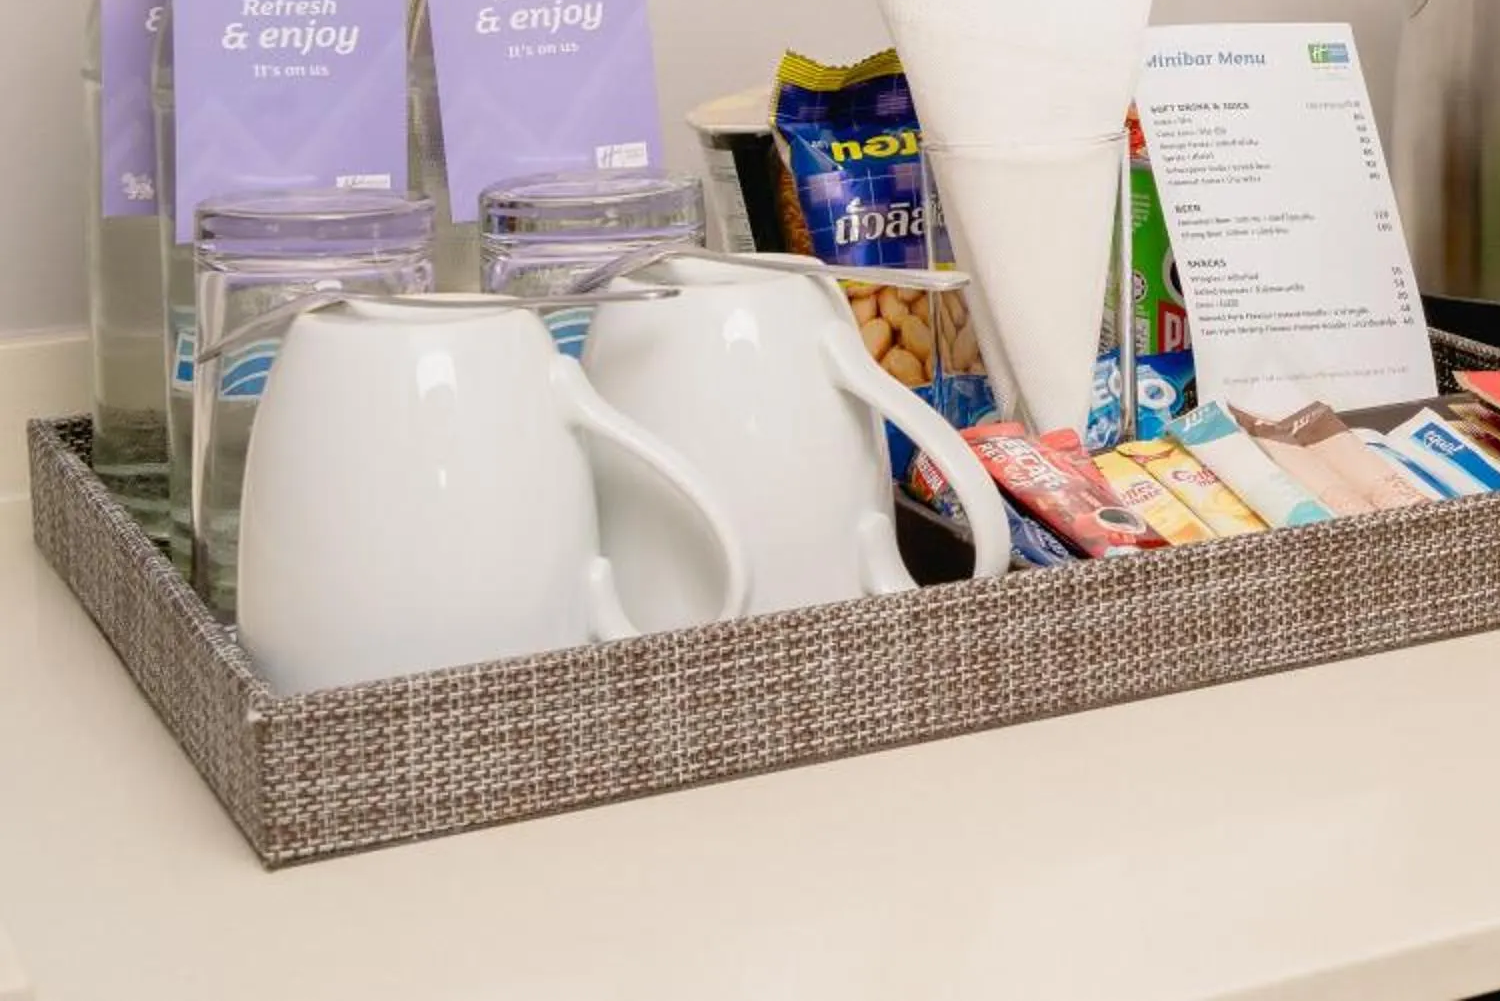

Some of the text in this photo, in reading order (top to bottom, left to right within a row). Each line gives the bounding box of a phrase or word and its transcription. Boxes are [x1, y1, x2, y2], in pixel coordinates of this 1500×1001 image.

[476, 0, 603, 34] & enjoy
[221, 19, 360, 55] & enjoy
[537, 43, 558, 55] on
[560, 41, 580, 53] us
[1218, 51, 1266, 65] Menu
[284, 64, 306, 76] on
[309, 62, 330, 76] us
